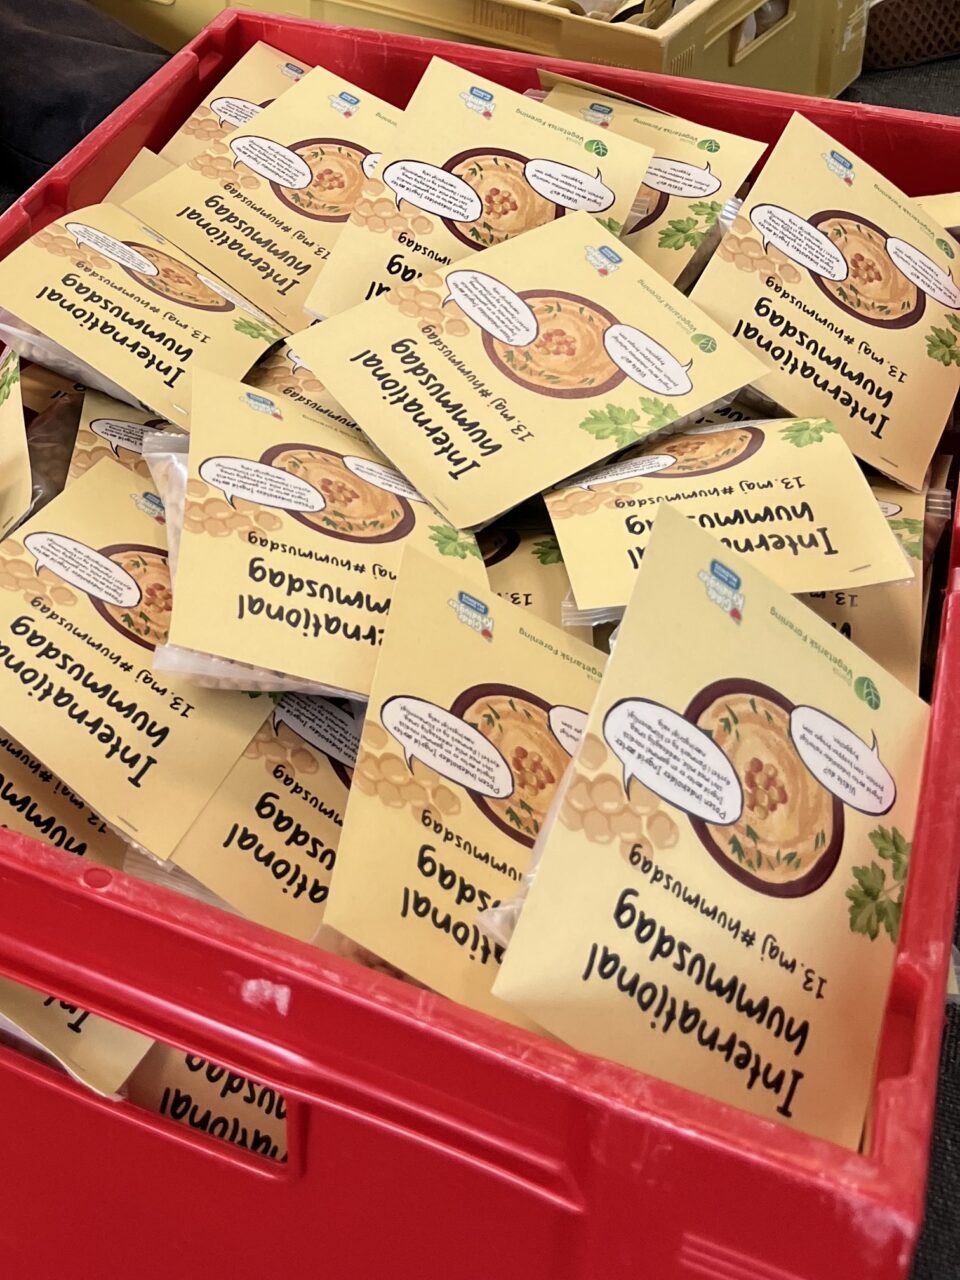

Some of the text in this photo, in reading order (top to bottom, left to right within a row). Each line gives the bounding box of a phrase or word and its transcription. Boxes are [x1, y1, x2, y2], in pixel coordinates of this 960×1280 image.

[515, 107, 583, 142] Vegetarisk Forening
[204, 194, 311, 275] hummusdag
[223, 182, 292, 232] #hummusdag
[292, 230, 314, 247] maj
[175, 206, 300, 295] International
[397, 231, 451, 265] musdag
[35, 286, 185, 388] International
[61, 273, 193, 362] hummusdag
[75, 260, 210, 343] 13. maj #hummusdag
[765, 275, 907, 383] 13. maj #hummusdag
[421, 324, 534, 441] 13. maj #hummusdag
[732, 319, 889, 439] International
[754, 296, 893, 408] hummusdag
[349, 349, 480, 480] International
[391, 338, 502, 456] hummusdag
[738, 480, 772, 494] maj
[771, 476, 805, 489] 13.
[247, 530, 365, 573] #hummusdag
[248, 556, 391, 615] mmusdag
[237, 594, 384, 646] rnational
[505, 592, 532, 606] 13.
[769, 606, 807, 642] Forening
[9, 615, 169, 747] hummusdag
[30, 596, 194, 718] 13. maj #hummusdag
[518, 626, 602, 678] egetarisk Forening
[809, 638, 852, 679] Vegetarisk
[254, 791, 336, 870] usdag
[272, 763, 342, 826] mmusdag
[222, 823, 329, 903] ational
[420, 808, 522, 881] ummusdag
[400, 887, 506, 964] ational
[628, 842, 827, 999] 13. maj #hummusdag
[613, 888, 809, 1057] hummusdag
[582, 943, 804, 1118] International
